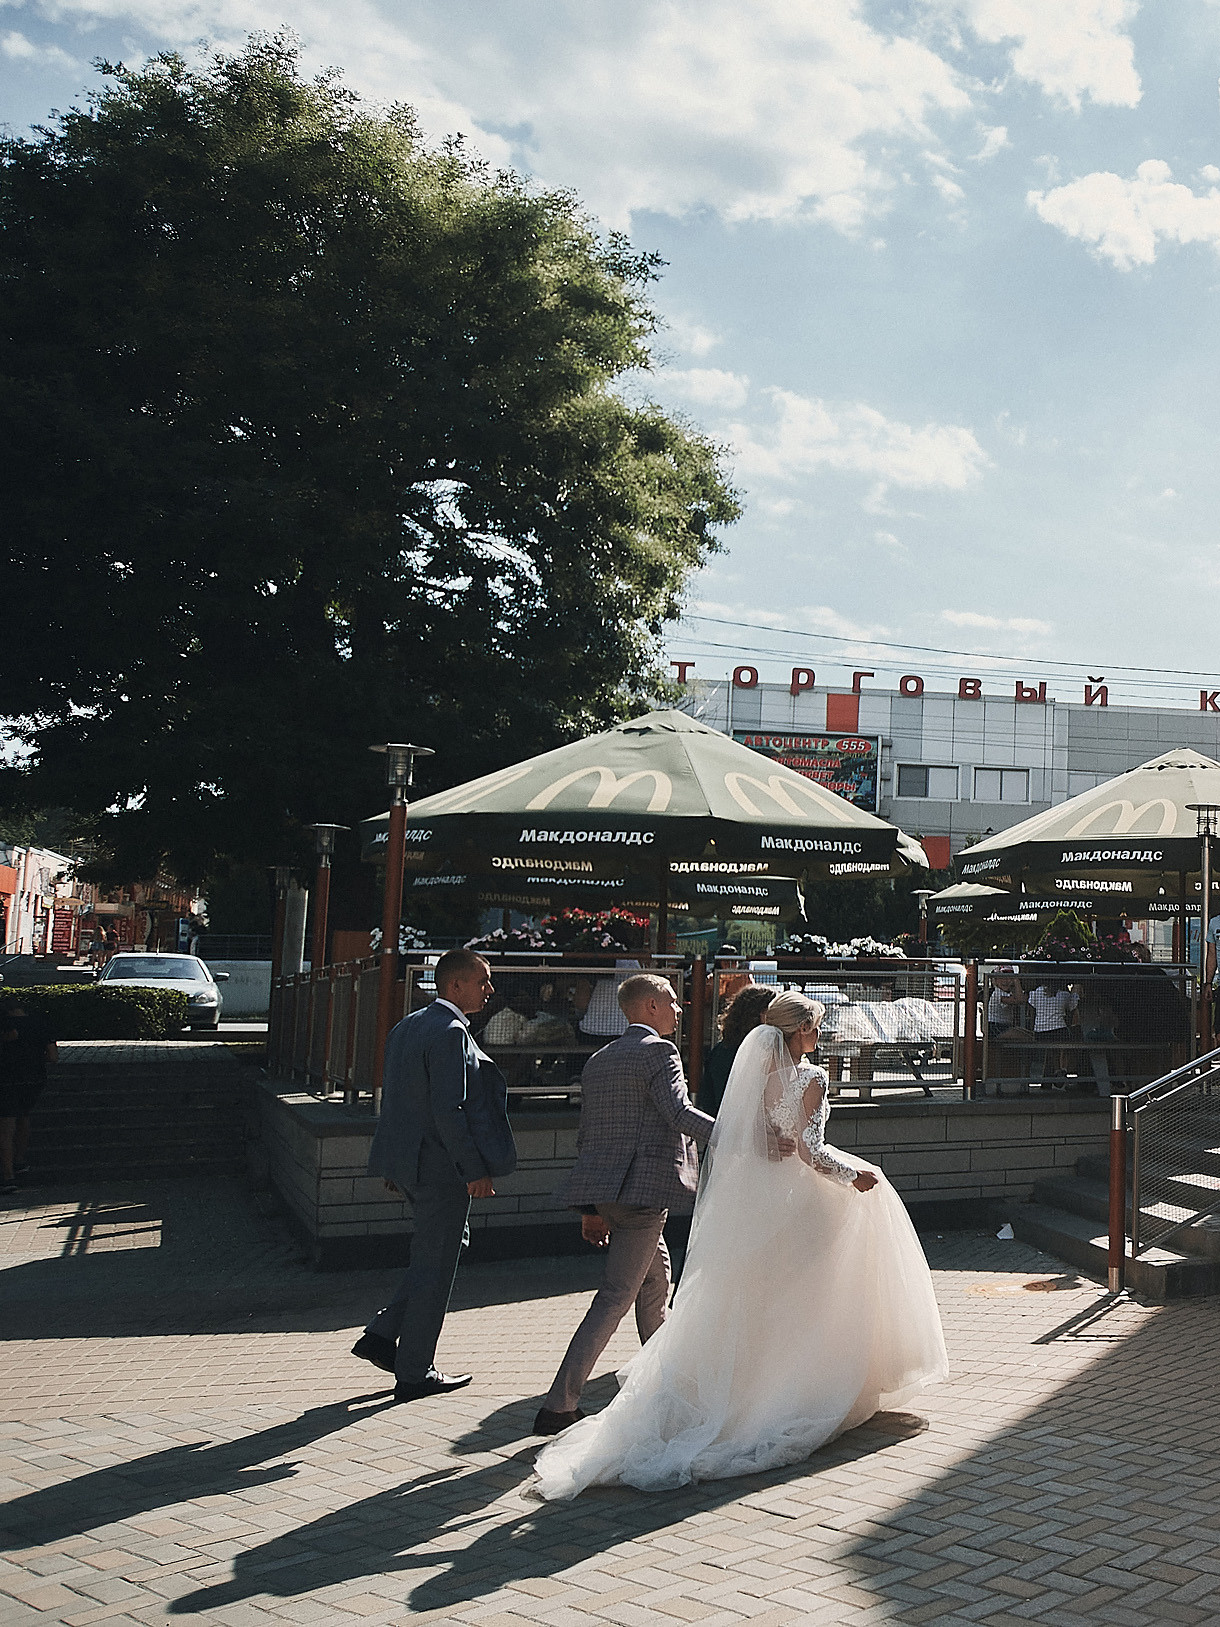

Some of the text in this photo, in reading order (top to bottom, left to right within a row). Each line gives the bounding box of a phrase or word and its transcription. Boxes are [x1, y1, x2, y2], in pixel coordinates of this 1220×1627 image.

[743, 735, 865, 751] АВТОЦЕНТР 555
[519, 829, 655, 845] Макдоналдс
[761, 836, 862, 854] Макдоналдс
[1061, 850, 1163, 863] Макдоналдс
[961, 857, 1001, 875] Макдоналдс
[696, 883, 769, 897] Макдоналдс
[1019, 900, 1093, 911] Макдоналдс
